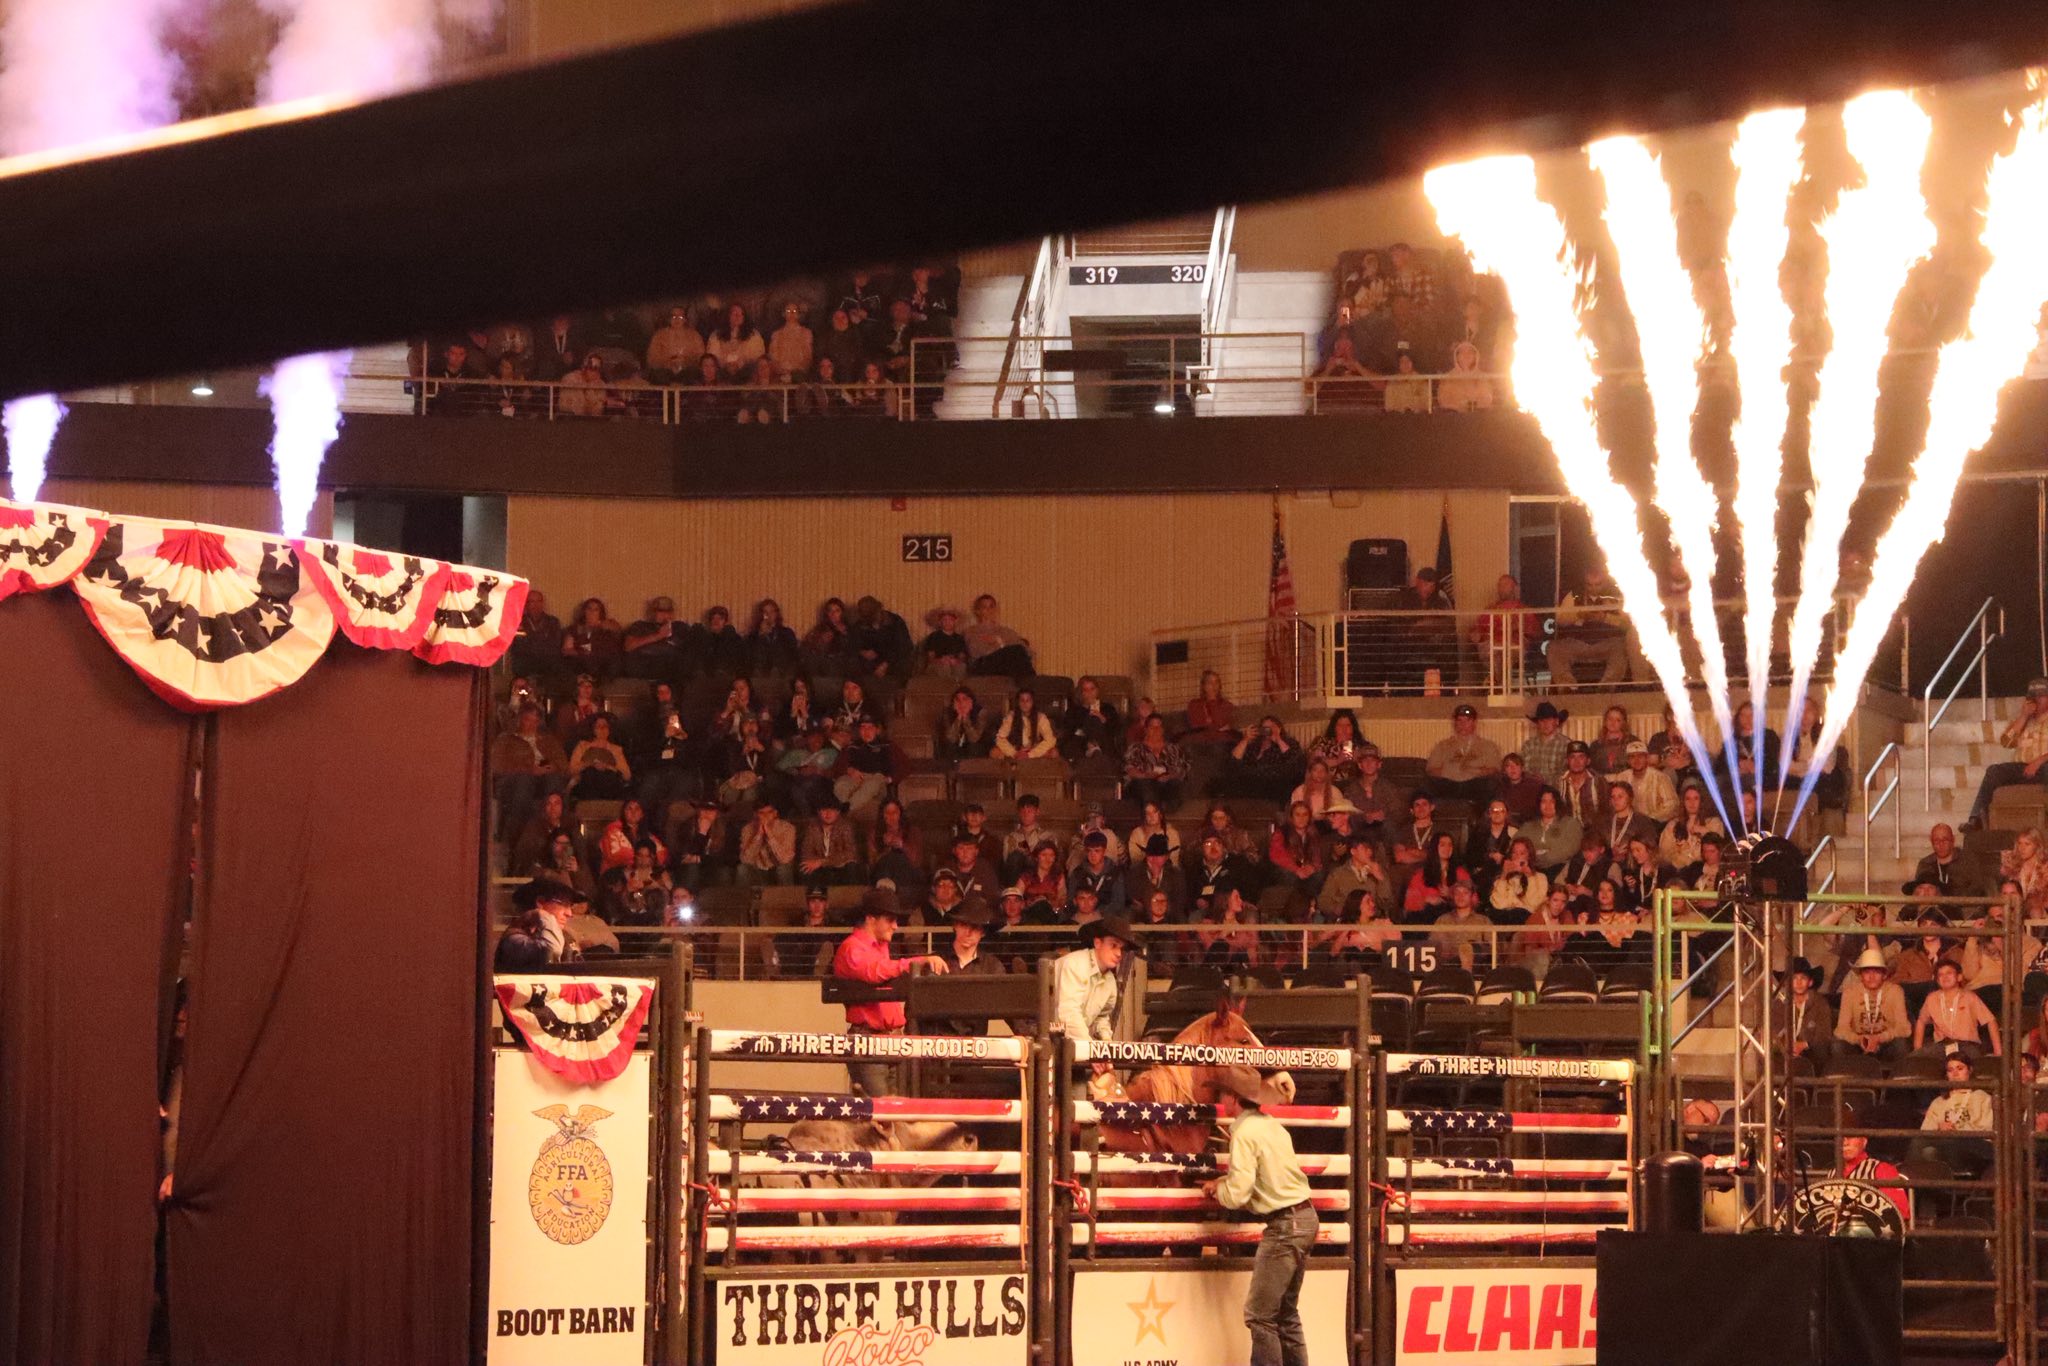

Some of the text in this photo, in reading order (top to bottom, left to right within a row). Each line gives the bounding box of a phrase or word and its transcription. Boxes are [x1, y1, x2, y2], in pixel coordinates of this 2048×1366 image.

[1085, 266, 1118, 284] 319
[1171, 265, 1204, 282] 320
[905, 538, 950, 560] 215
[1386, 946, 1437, 972] 115
[777, 1034, 989, 1058] THREE HILLS RODEO
[1089, 1041, 1339, 1068] NATIONAL FFA CONVENTION & EXPO
[1437, 1058, 1600, 1078] THREE HILLS RODEO
[543, 1151, 600, 1183] AGRICULTURAL
[557, 1164, 588, 1181] FFA
[546, 1207, 595, 1229] EDUCATION
[496, 1306, 636, 1337] BOOT BARN
[724, 1276, 1026, 1347] THREE HILLS
[823, 1319, 935, 1366] Rodeo
